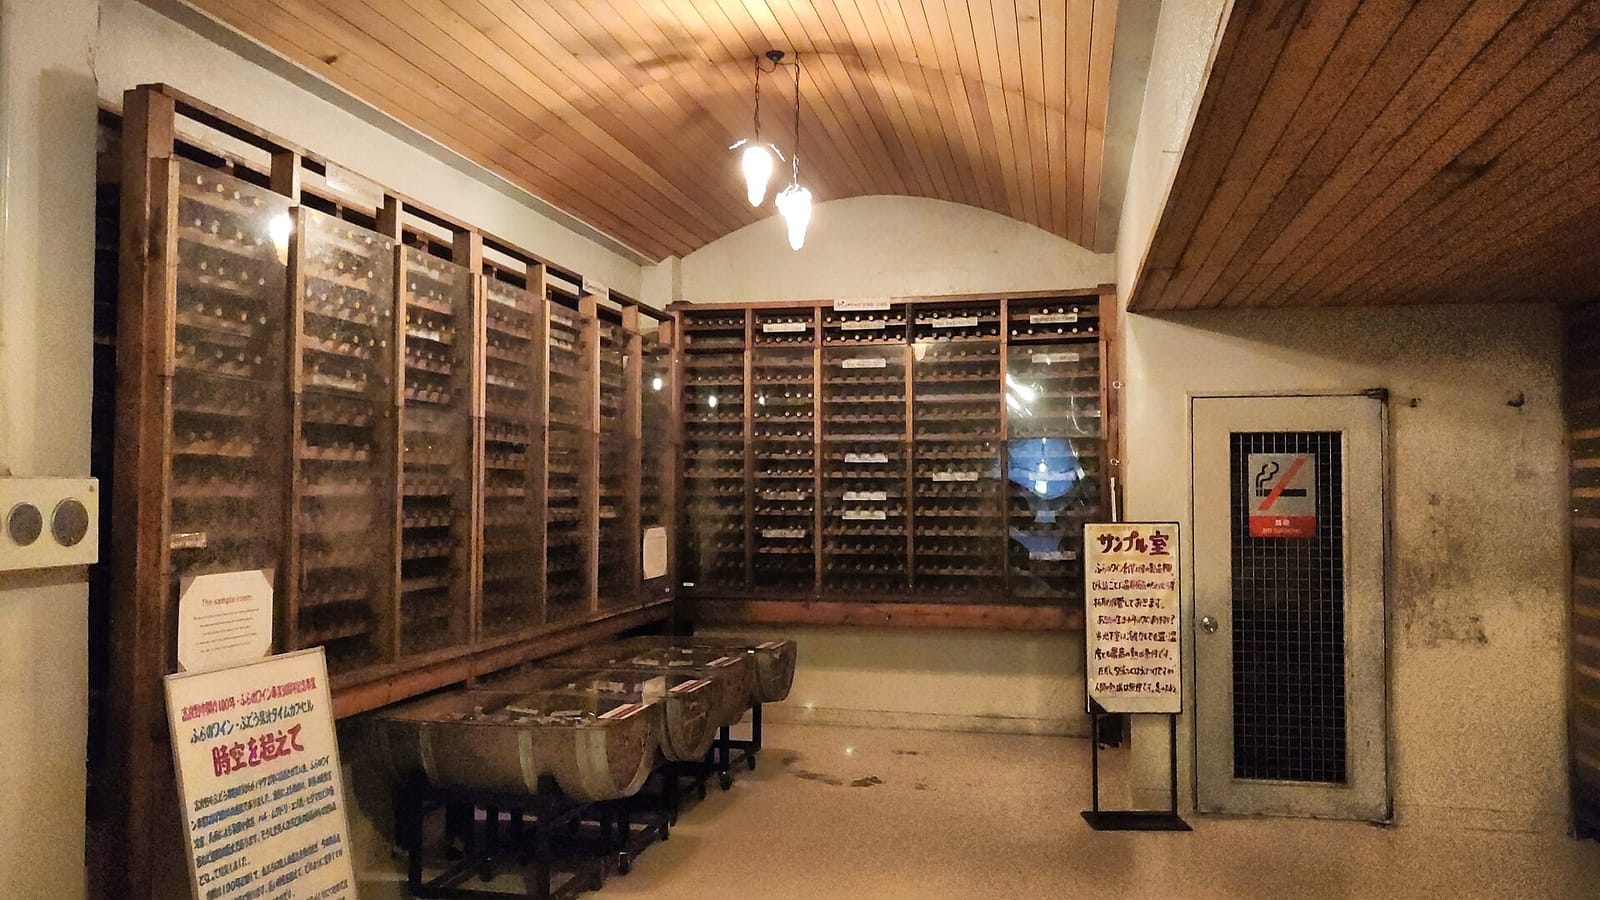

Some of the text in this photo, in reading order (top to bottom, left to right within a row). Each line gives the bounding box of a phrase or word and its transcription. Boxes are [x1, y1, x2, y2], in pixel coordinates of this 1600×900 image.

[1097, 530, 1170, 555] サンプル室
[201, 598, 213, 607] The
[212, 723, 305, 777] 時空を超えて
